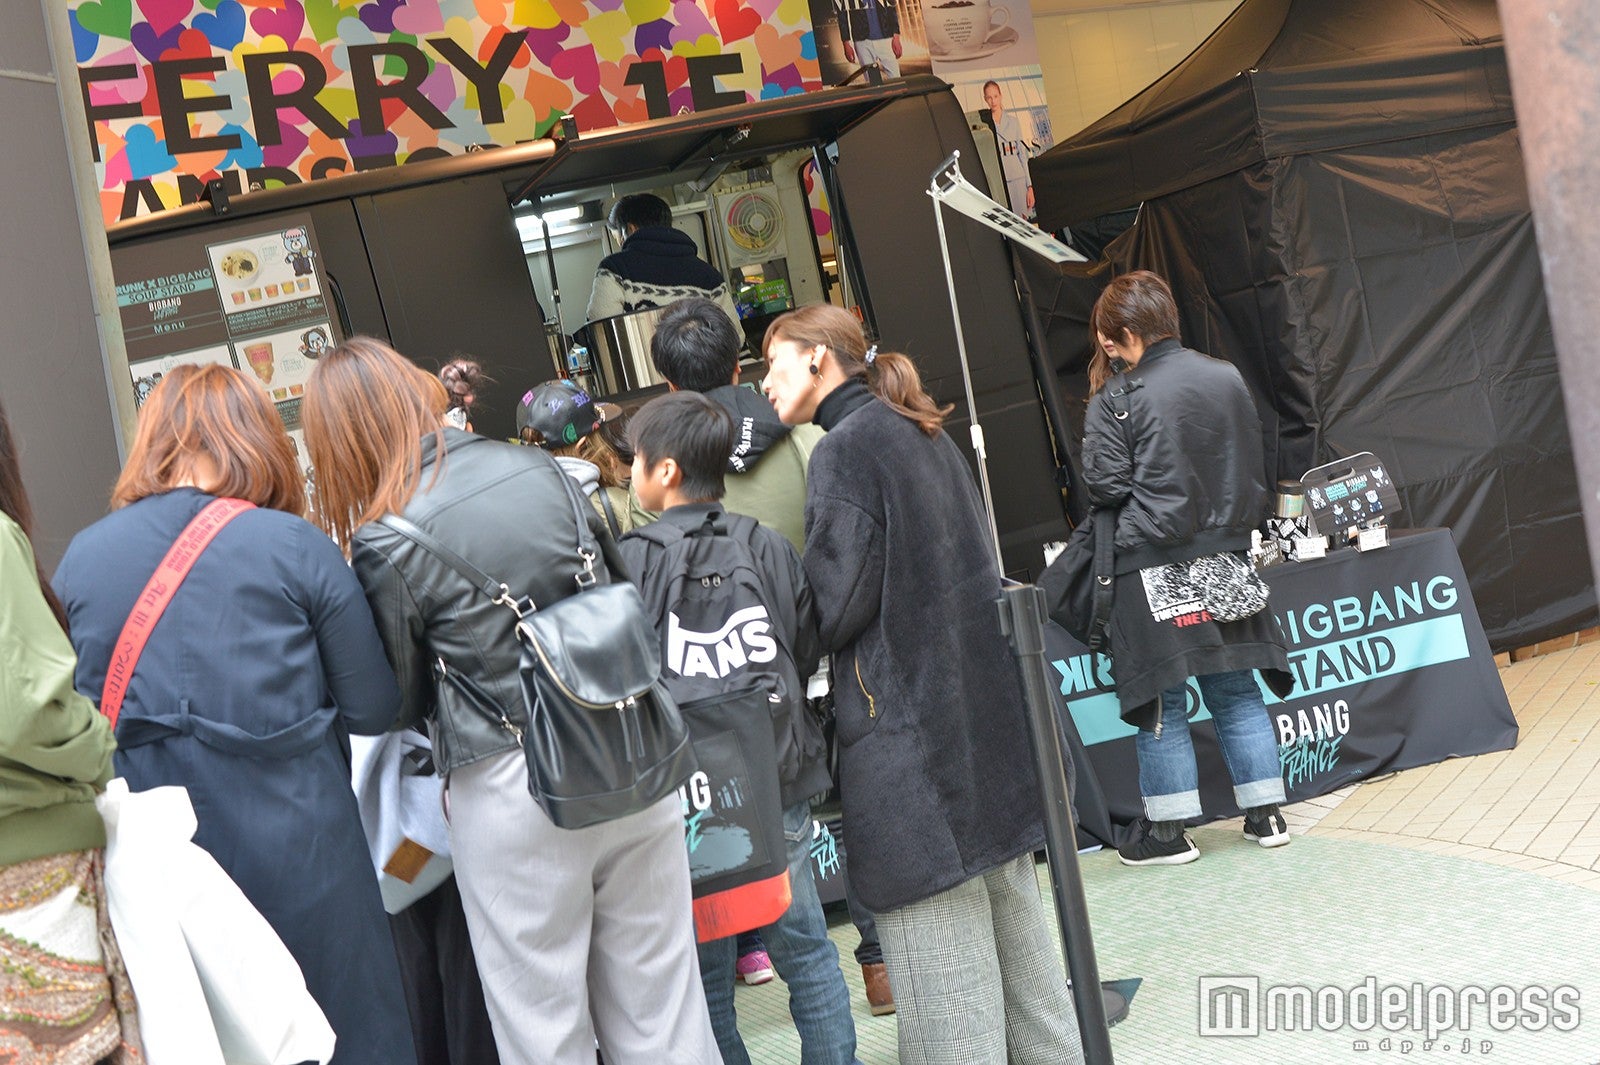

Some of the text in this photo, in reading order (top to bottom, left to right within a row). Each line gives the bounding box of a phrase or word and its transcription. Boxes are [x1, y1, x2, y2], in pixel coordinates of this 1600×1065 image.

[78, 30, 530, 163] FERRY
[115, 282, 146, 296] RUNK
[157, 268, 212, 287] BIGBANG
[128, 282, 196, 304] SOUP STAND
[148, 296, 182, 312] BIGBANG
[153, 321, 186, 334] Menu
[173, 550, 193, 573] TOUR
[668, 605, 778, 679] VANS
[1287, 635, 1396, 692] TAND
[1276, 699, 1350, 748] BANG
